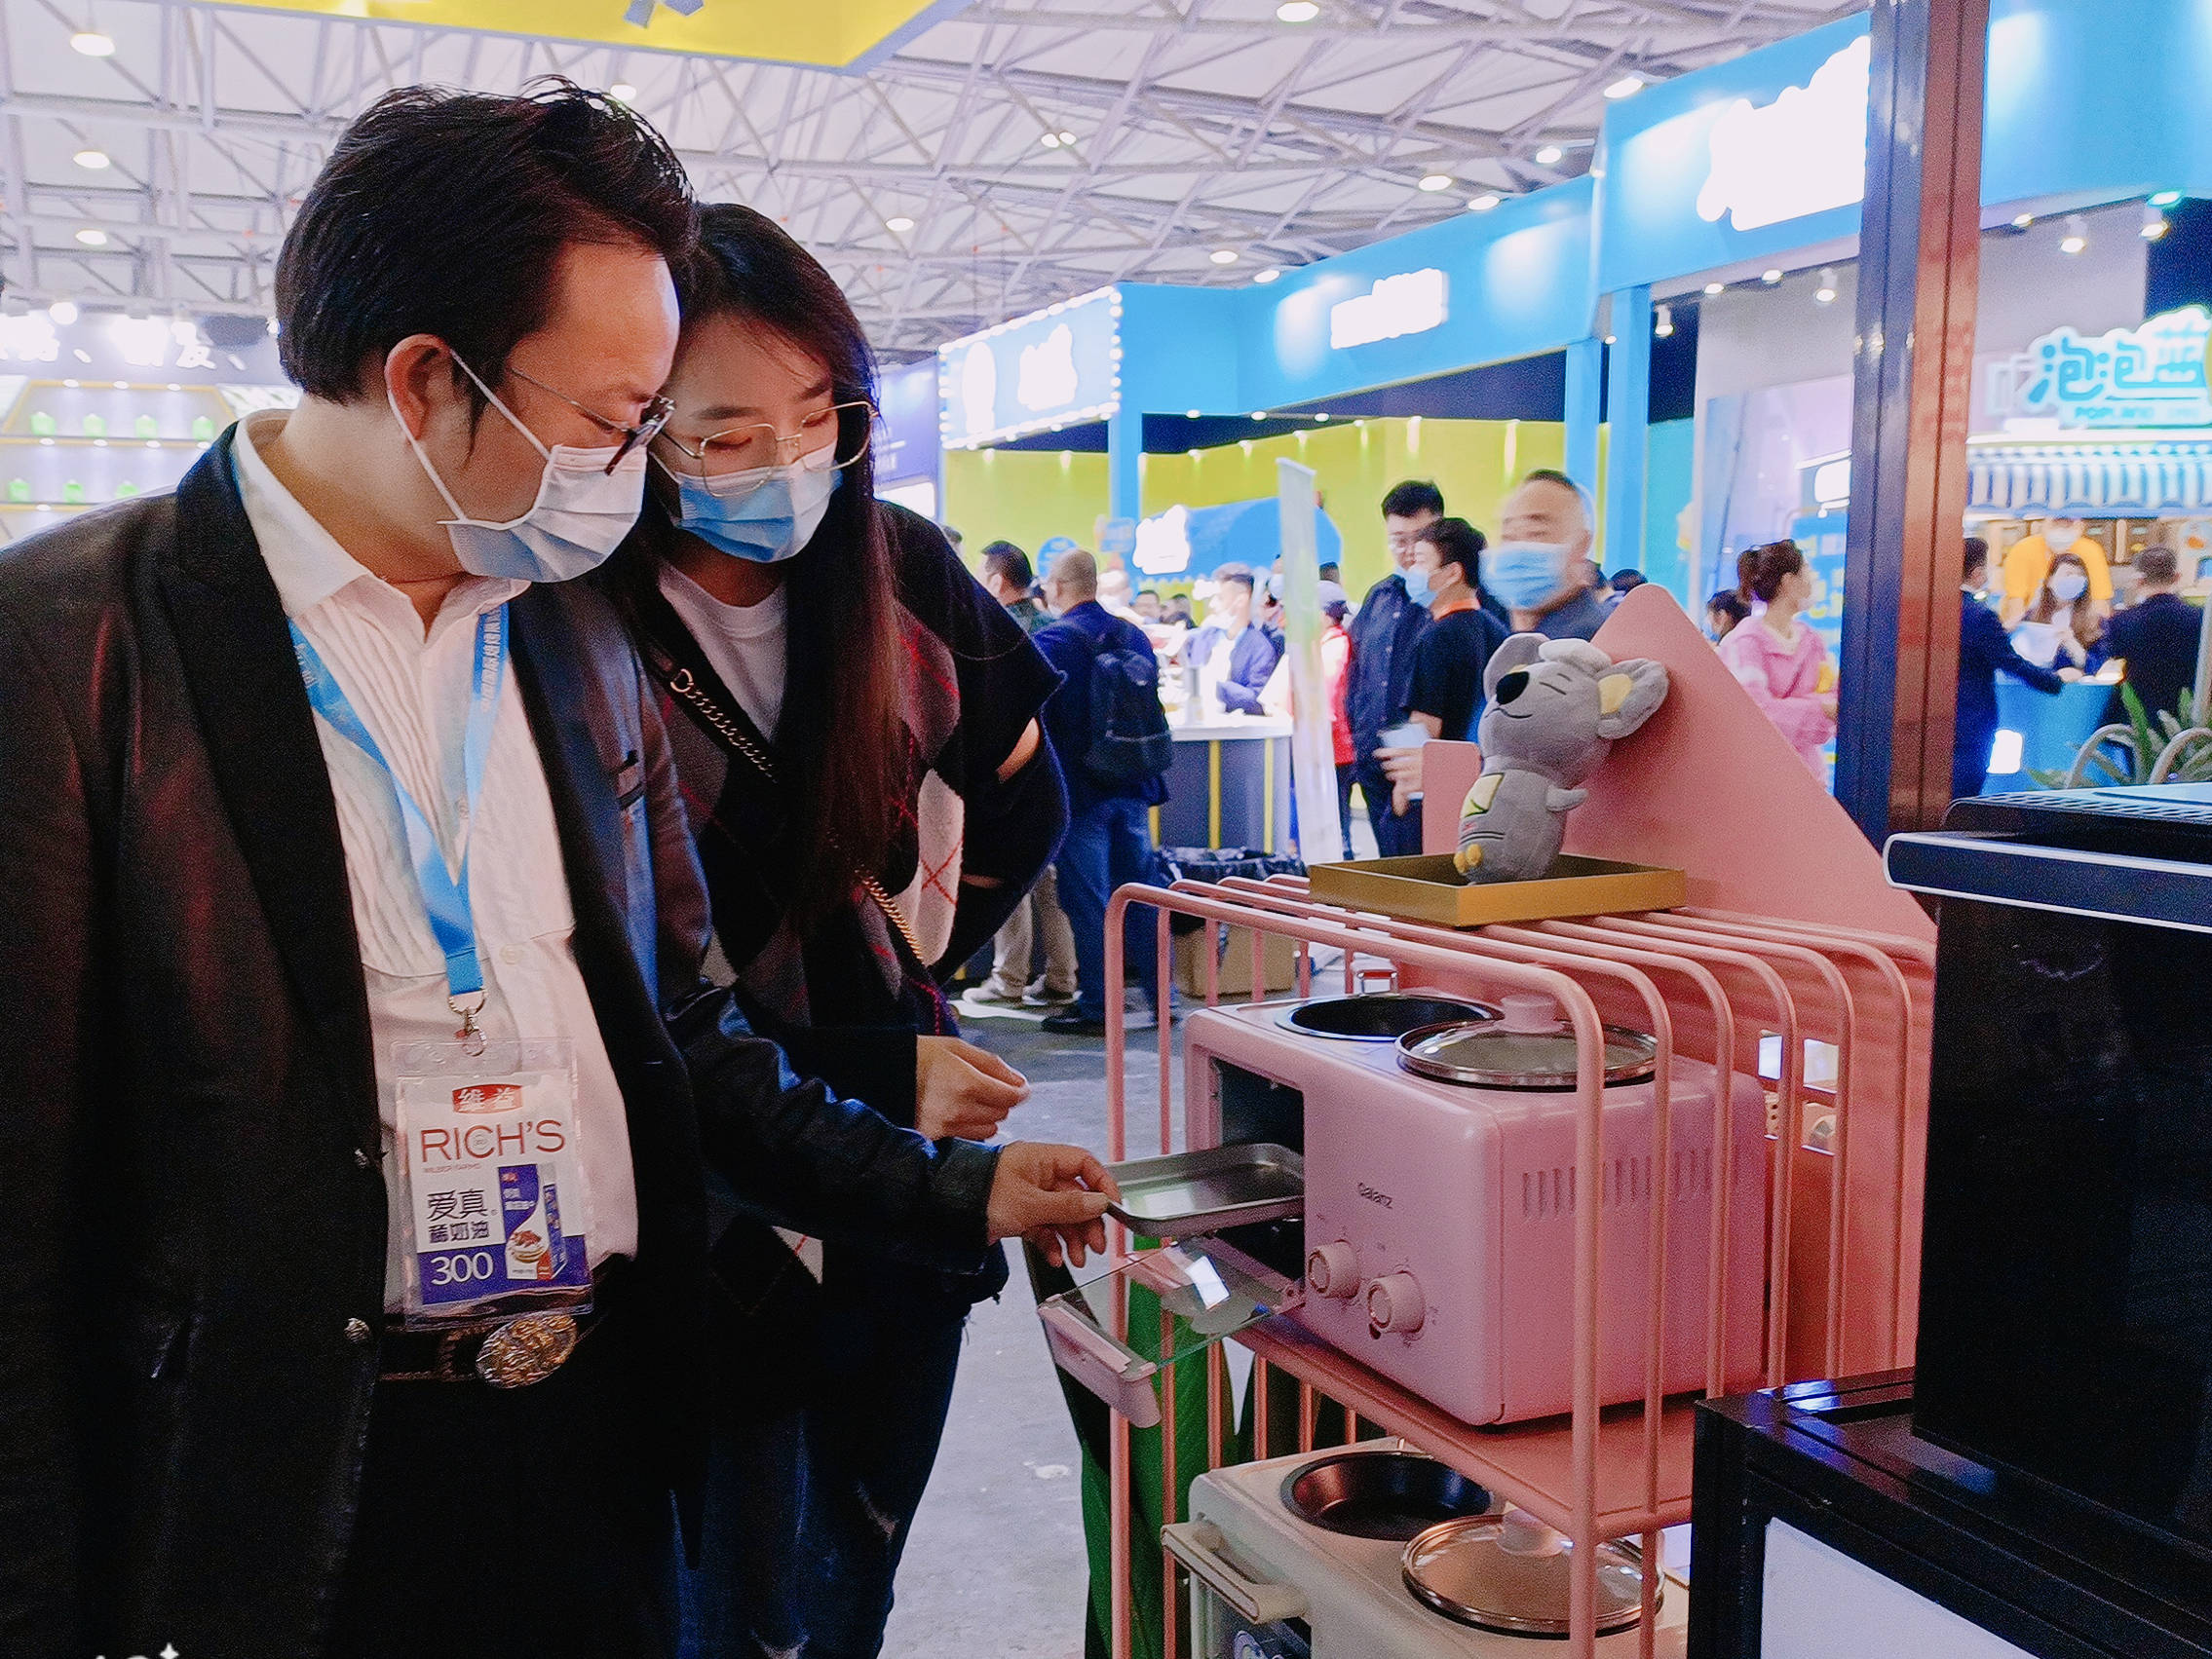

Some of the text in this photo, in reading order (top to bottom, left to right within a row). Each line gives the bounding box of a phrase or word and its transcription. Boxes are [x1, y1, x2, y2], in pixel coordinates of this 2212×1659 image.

[420, 1119, 565, 1163] RICH'S
[426, 1188, 488, 1222] 爱真
[430, 1252, 494, 1286] 300
